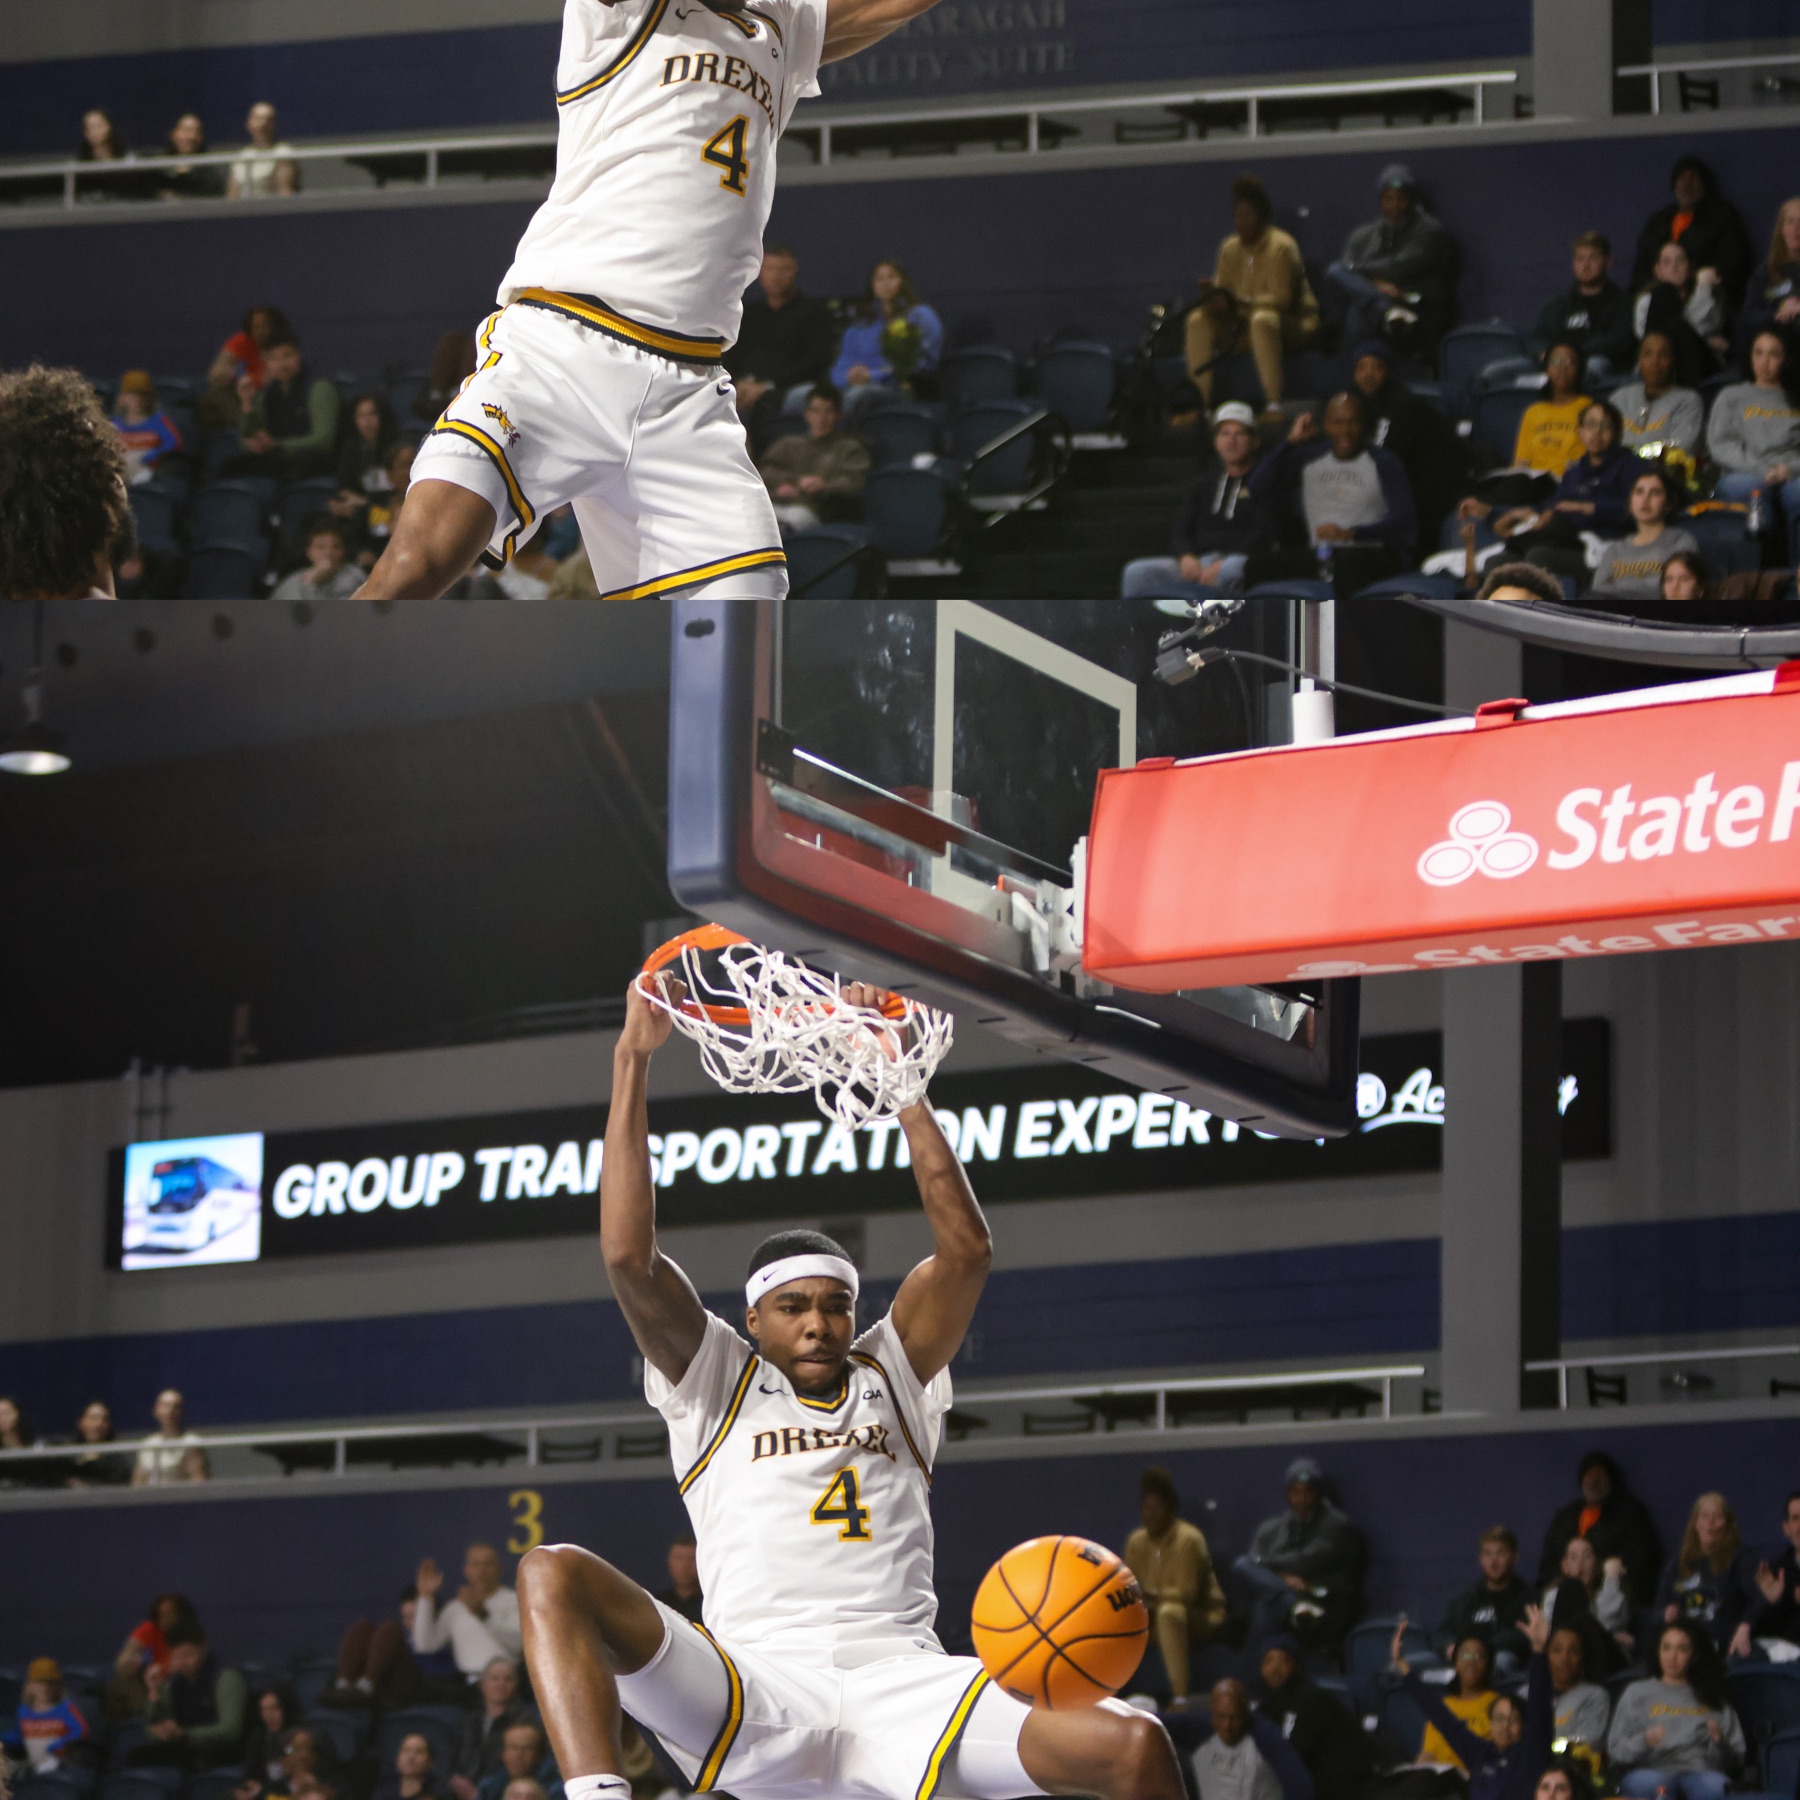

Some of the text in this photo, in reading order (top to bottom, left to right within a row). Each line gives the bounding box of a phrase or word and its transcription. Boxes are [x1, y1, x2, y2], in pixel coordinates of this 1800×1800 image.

[700, 113, 751, 198] 4
[1546, 771, 1765, 870] State
[1413, 915, 1800, 967] State Far
[272, 1151, 466, 1220] GROUP
[1013, 1091, 1281, 1159] EXPER
[507, 1488, 545, 1555] 3
[810, 1465, 873, 1543] 4
